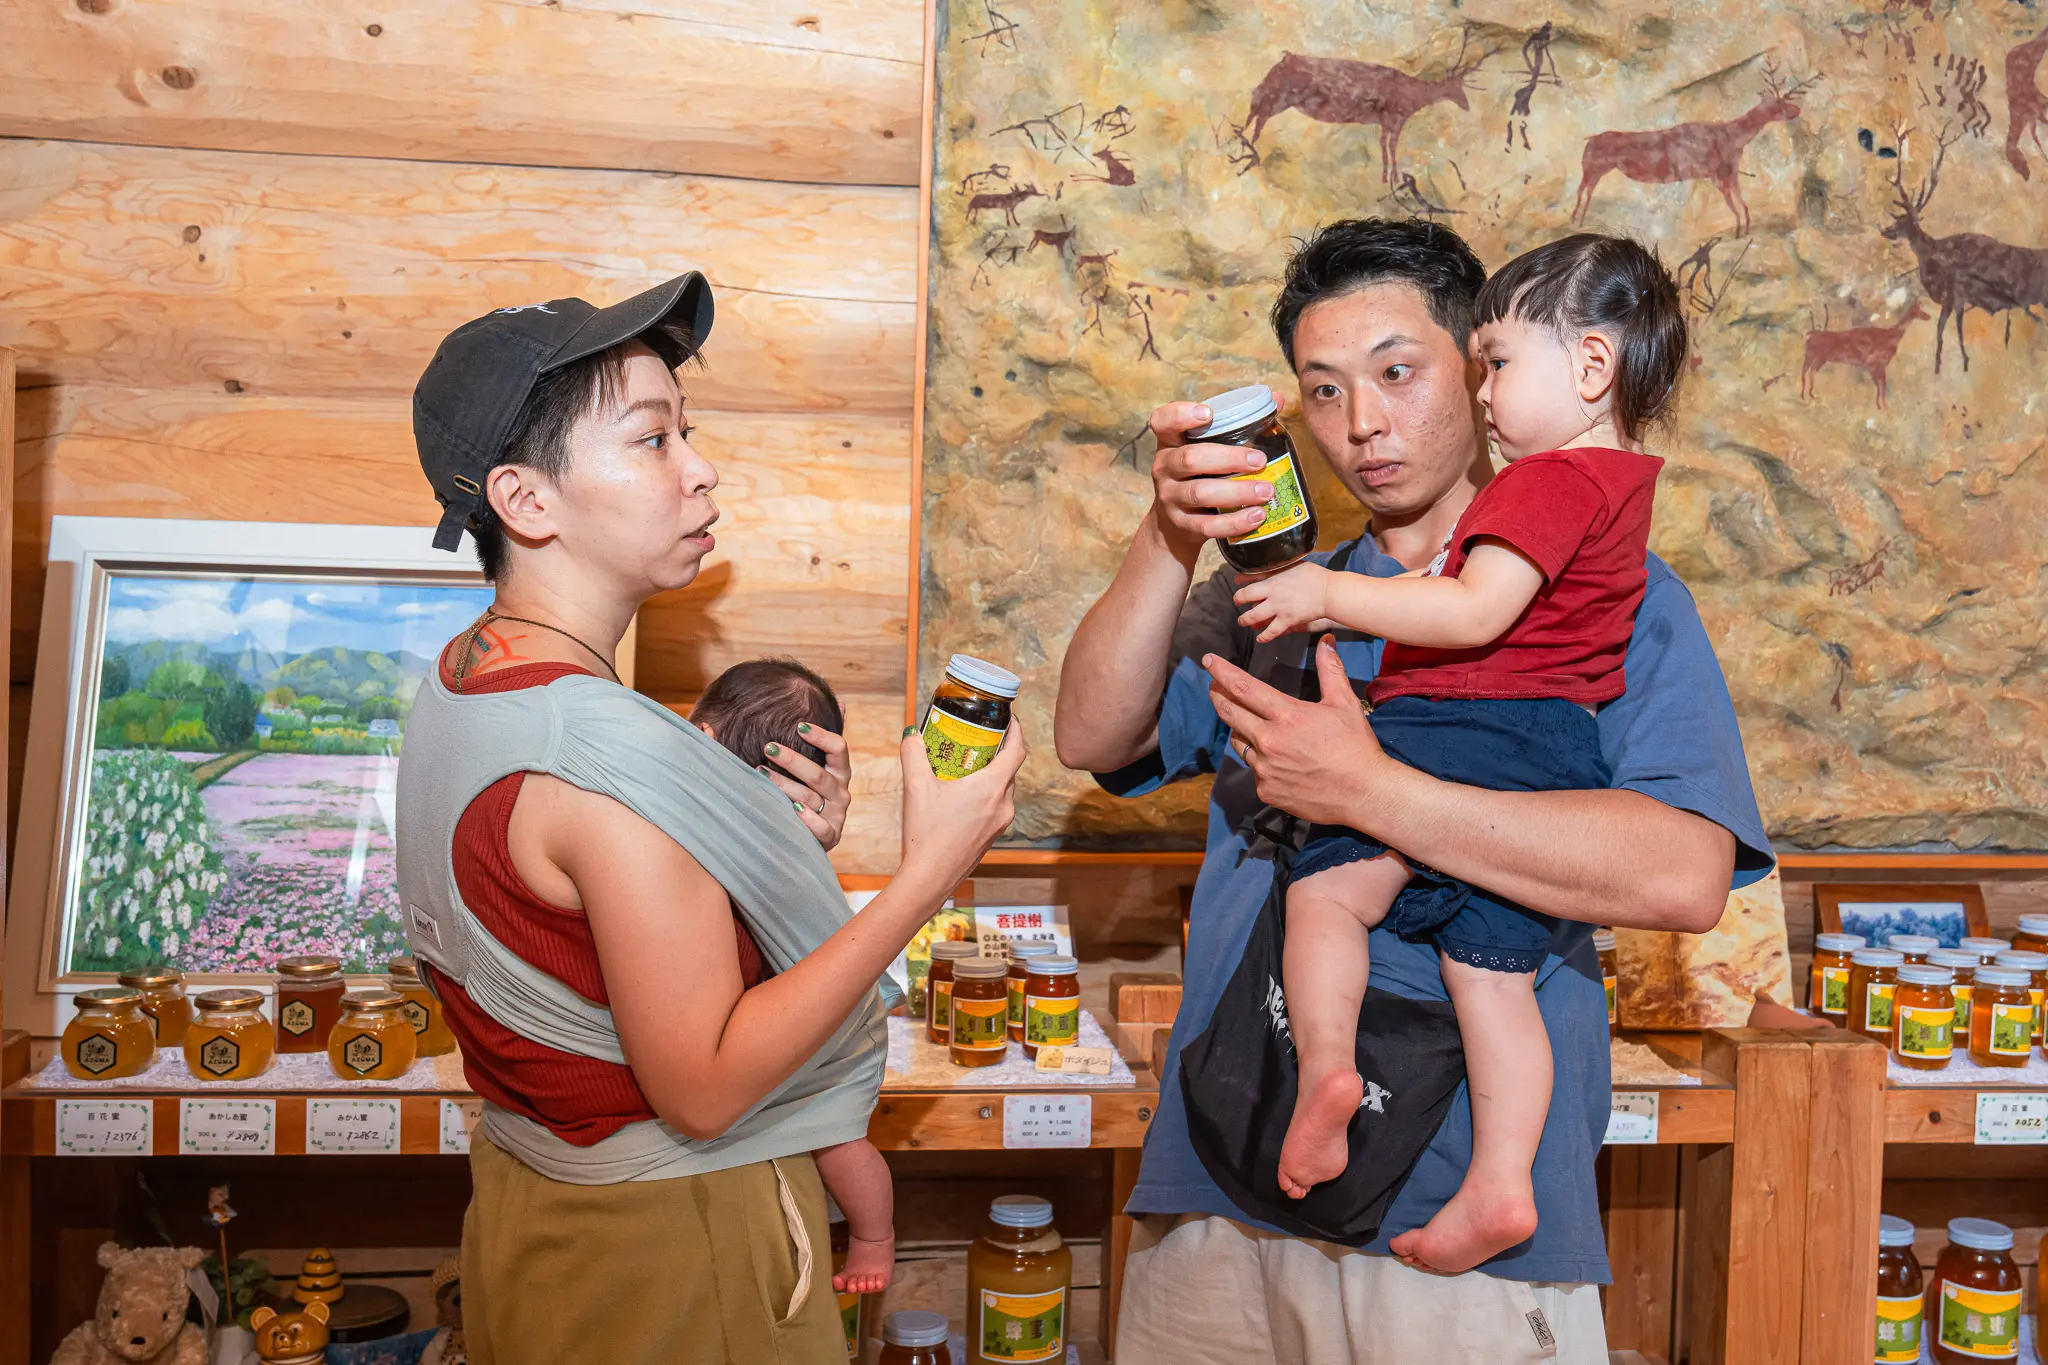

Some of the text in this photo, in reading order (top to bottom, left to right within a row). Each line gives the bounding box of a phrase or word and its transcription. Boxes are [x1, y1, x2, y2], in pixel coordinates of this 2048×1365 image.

[996, 913, 1043, 928] 菩提樹
[209, 1112, 248, 1121] あかしあ蜜
[337, 1113, 368, 1122] みかん蜜
